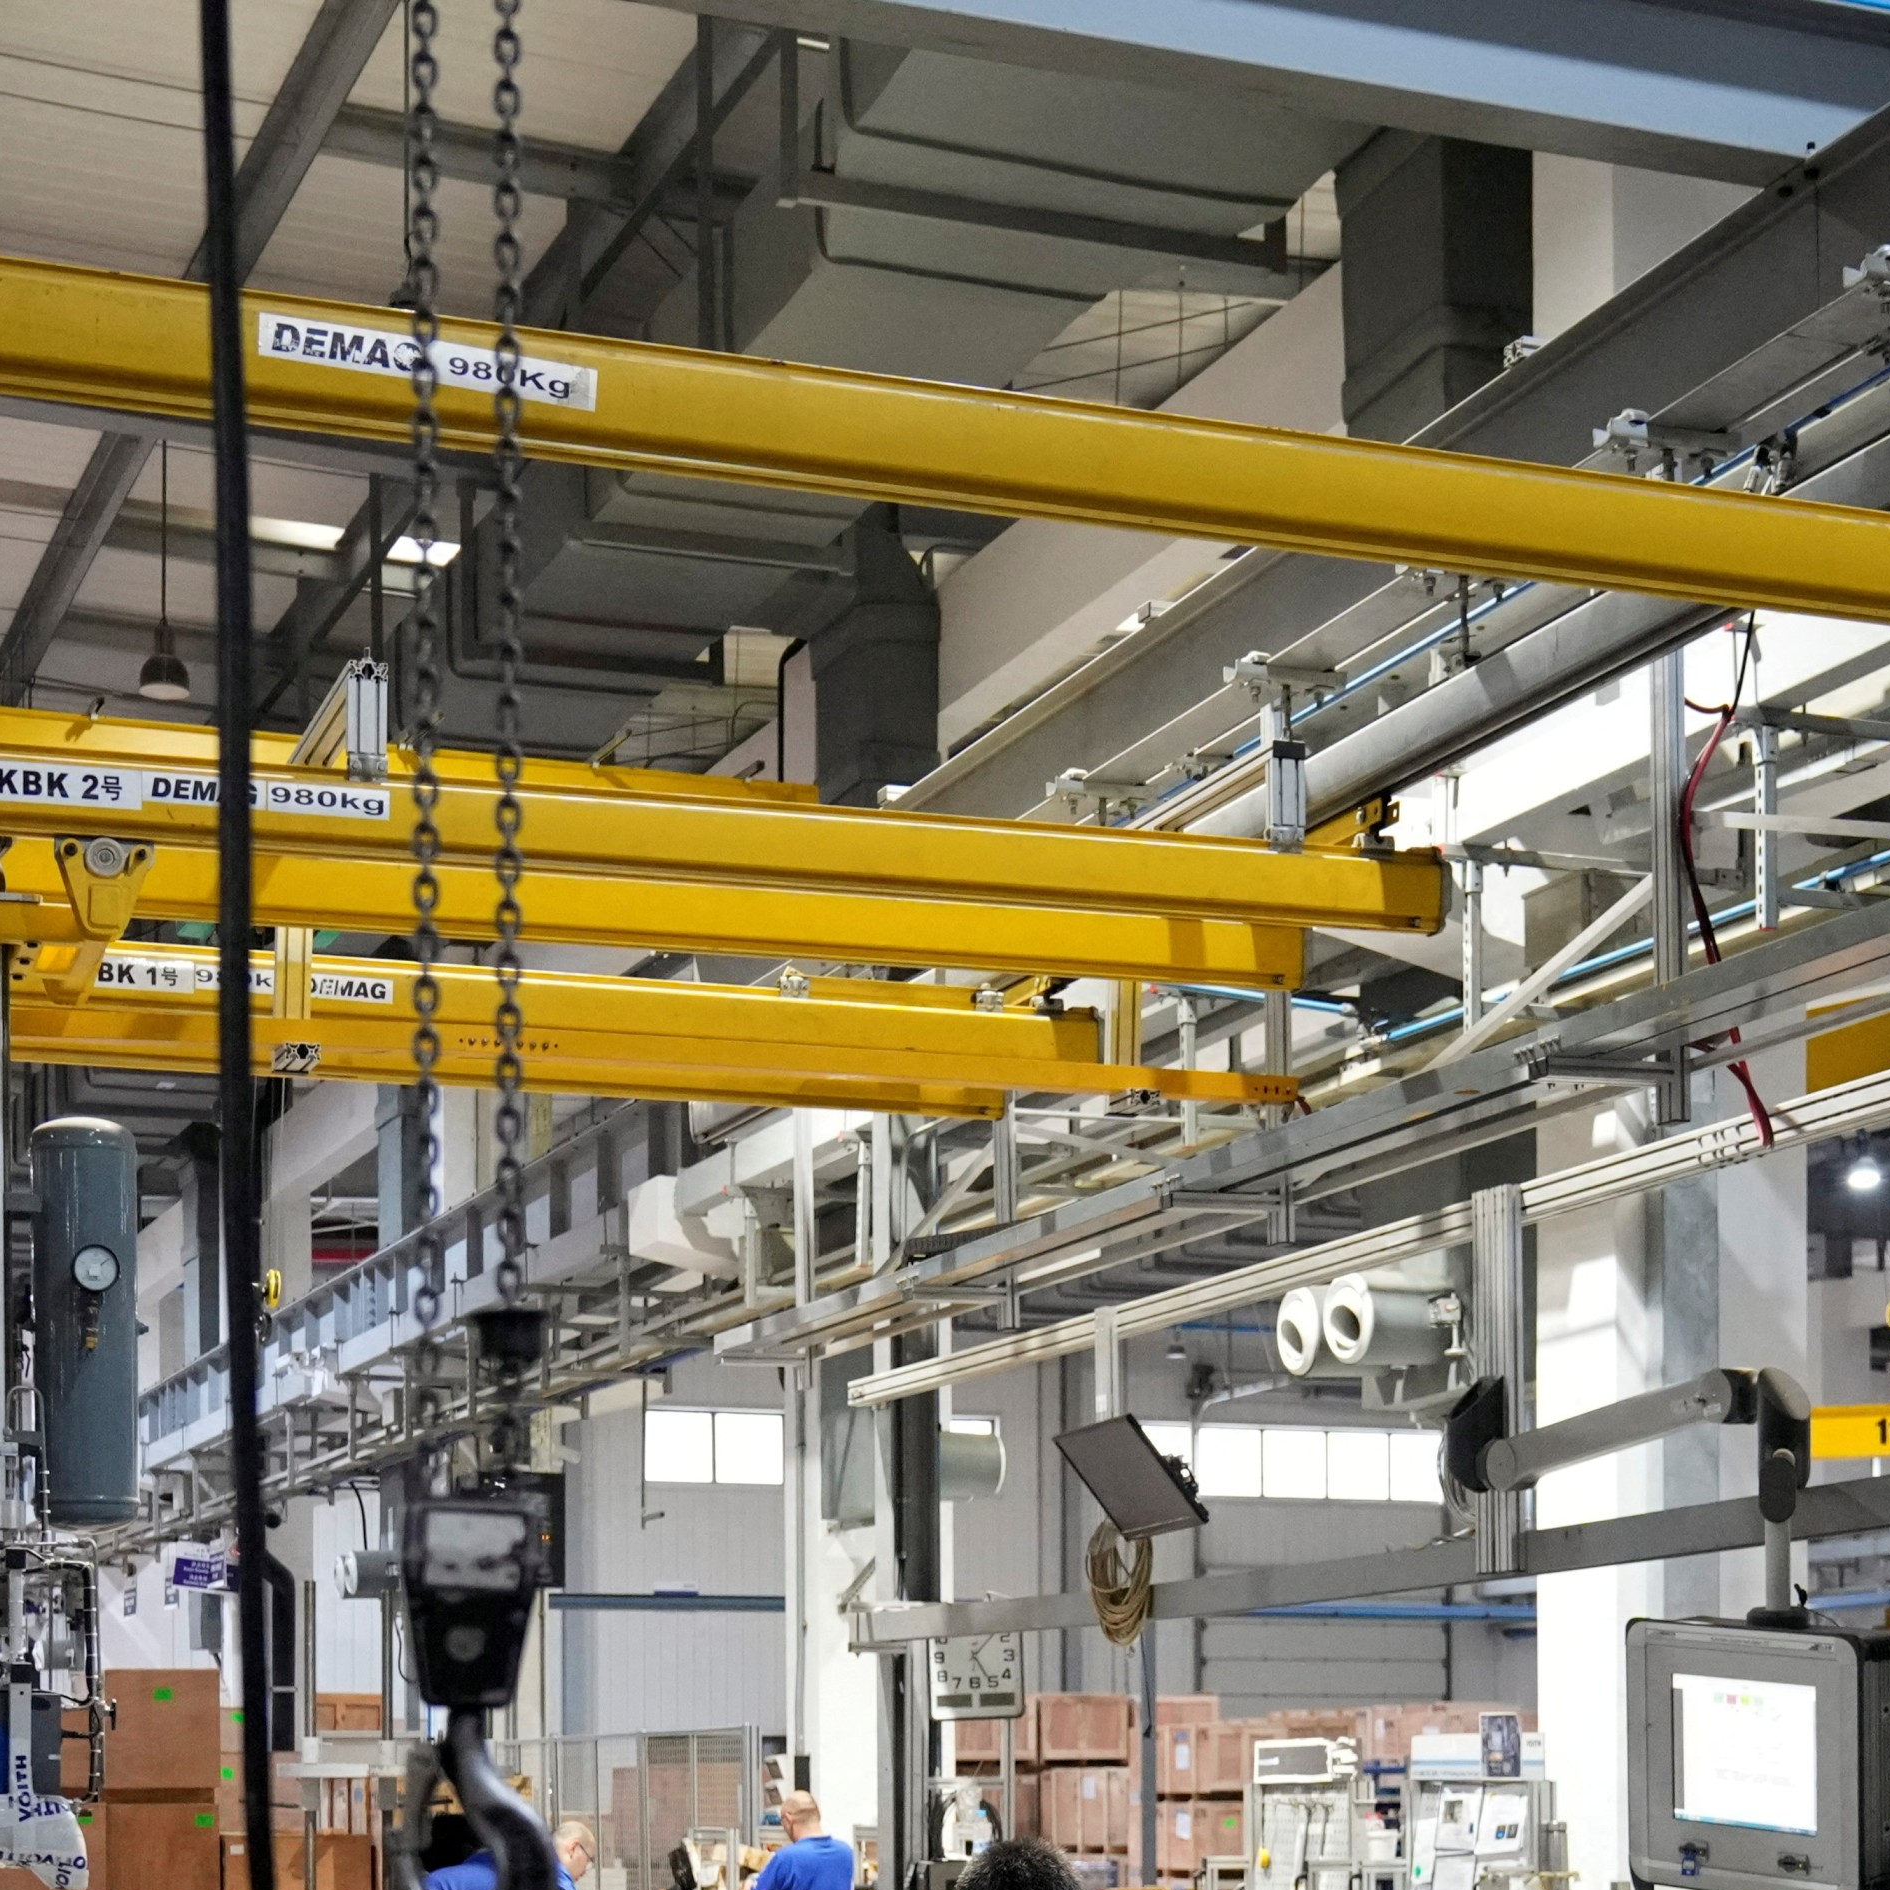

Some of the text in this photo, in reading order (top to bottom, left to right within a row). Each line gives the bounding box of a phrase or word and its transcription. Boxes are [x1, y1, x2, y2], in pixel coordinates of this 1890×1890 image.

[81, 773, 123, 802] 2号
[151, 776, 385, 815] DEMG 980kg
[97, 963, 136, 986] BK
[145, 965, 179, 988] 1号
[934, 1651, 945, 1664] 9
[1003, 1649, 1015, 1662] 3
[937, 1670, 948, 1682] 8
[1001, 1668, 1012, 1680] 4
[951, 1676, 962, 1690] 7
[969, 1676, 981, 1689] 6
[987, 1675, 999, 1688] 5
[15, 1754, 33, 1822] VOITH
